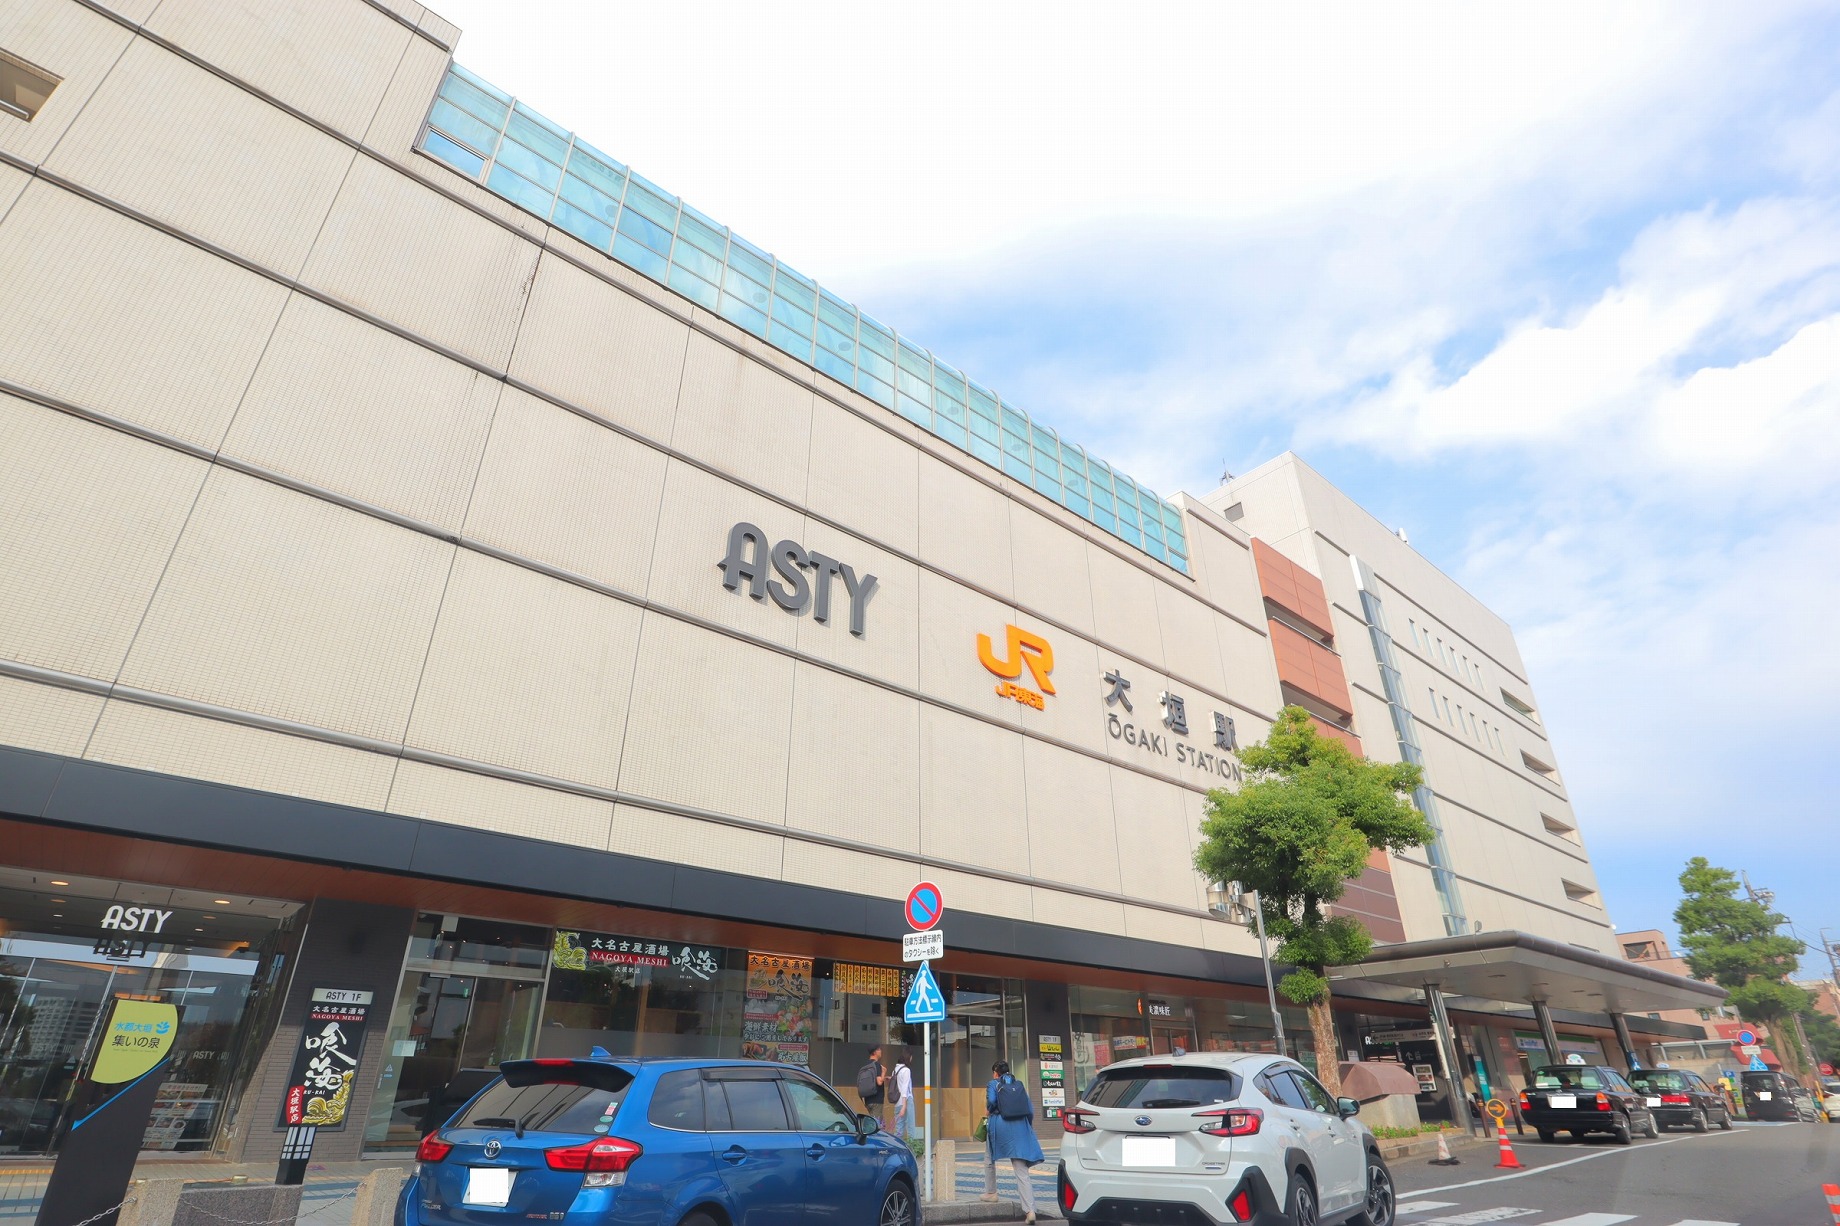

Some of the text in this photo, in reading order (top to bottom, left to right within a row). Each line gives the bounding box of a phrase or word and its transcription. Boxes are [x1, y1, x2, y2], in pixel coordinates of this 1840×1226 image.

[717, 522, 878, 637] ASTY
[976, 624, 1056, 695] JR
[995, 681, 1045, 712] JR東海
[1103, 669, 1239, 752] 大垣駅
[1107, 712, 1242, 782] ŌGAKI STATION
[101, 905, 173, 933] ASTY
[591, 938, 669, 956] 大名古屋酒場
[904, 946, 940, 958] のタクシーを除く
[591, 952, 667, 967] NAGOYA MESHI
[750, 956, 811, 970] 大名古屋酒場
[325, 991, 362, 1002] ASTY 1F
[312, 1005, 366, 1016] 大名古屋酒場
[113, 1021, 153, 1034] 水都大垣
[111, 1034, 161, 1049] 集いの泉
[193, 1050, 215, 1060] ASTY
